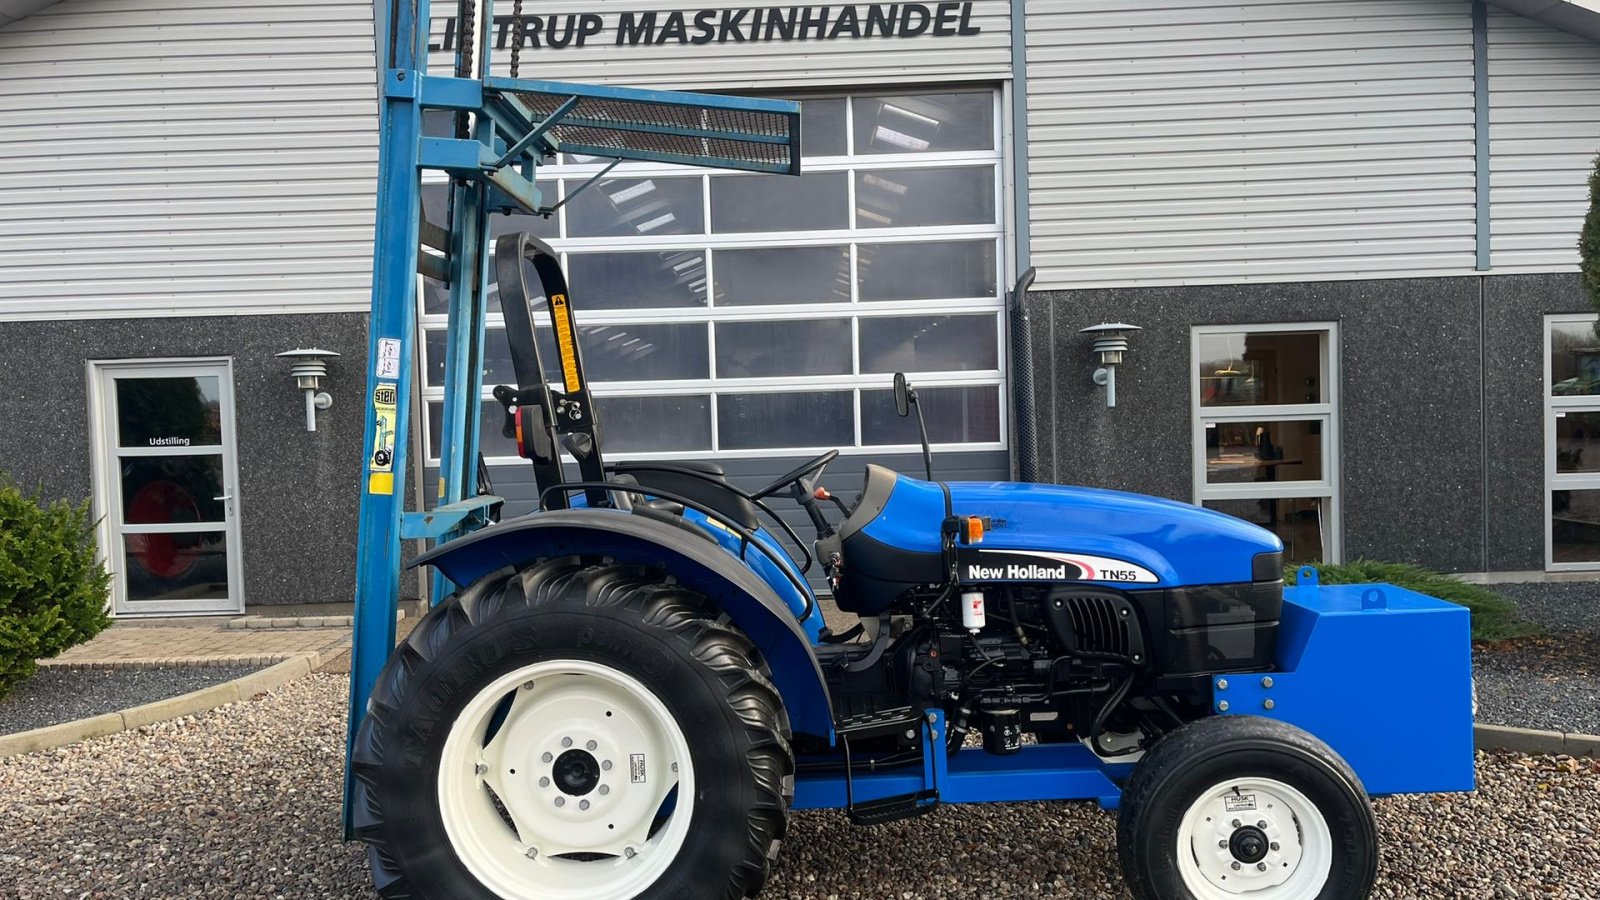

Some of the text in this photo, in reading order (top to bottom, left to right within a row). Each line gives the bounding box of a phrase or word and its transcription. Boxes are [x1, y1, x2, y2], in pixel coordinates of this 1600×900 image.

[427, 1, 981, 52] ITRUP MASKINHANDEL
[149, 436, 190, 446] Udstilling
[968, 565, 1066, 580] New Holland
[1100, 569, 1137, 581] TN55
